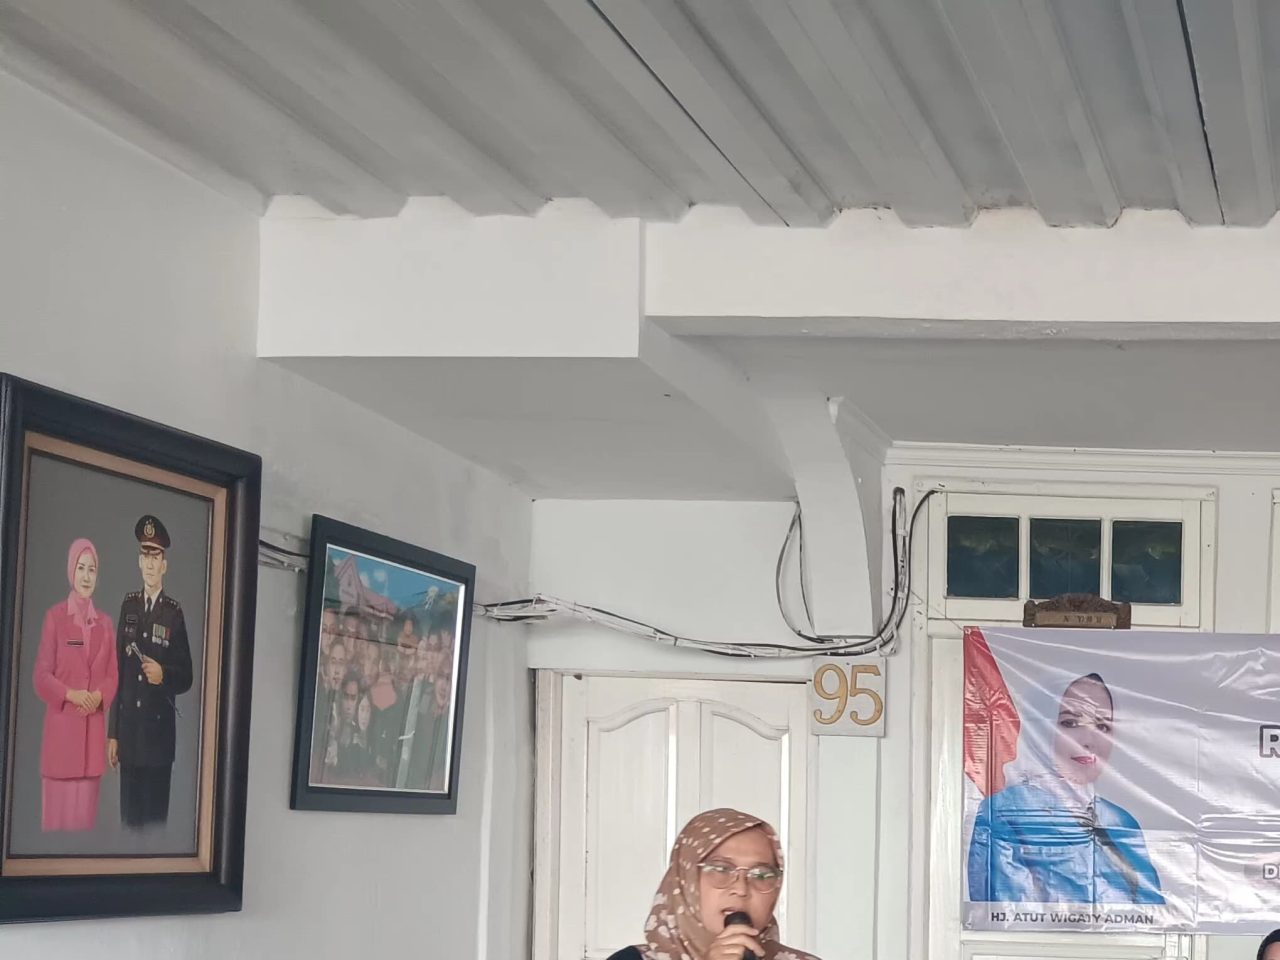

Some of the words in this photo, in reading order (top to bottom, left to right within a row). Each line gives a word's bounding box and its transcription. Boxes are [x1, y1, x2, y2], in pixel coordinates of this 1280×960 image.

[813, 663, 884, 726] 95
[991, 912, 1009, 922] HJ.
[1013, 912, 1047, 922] ATUT
[1104, 914, 1154, 924] ADMAN
